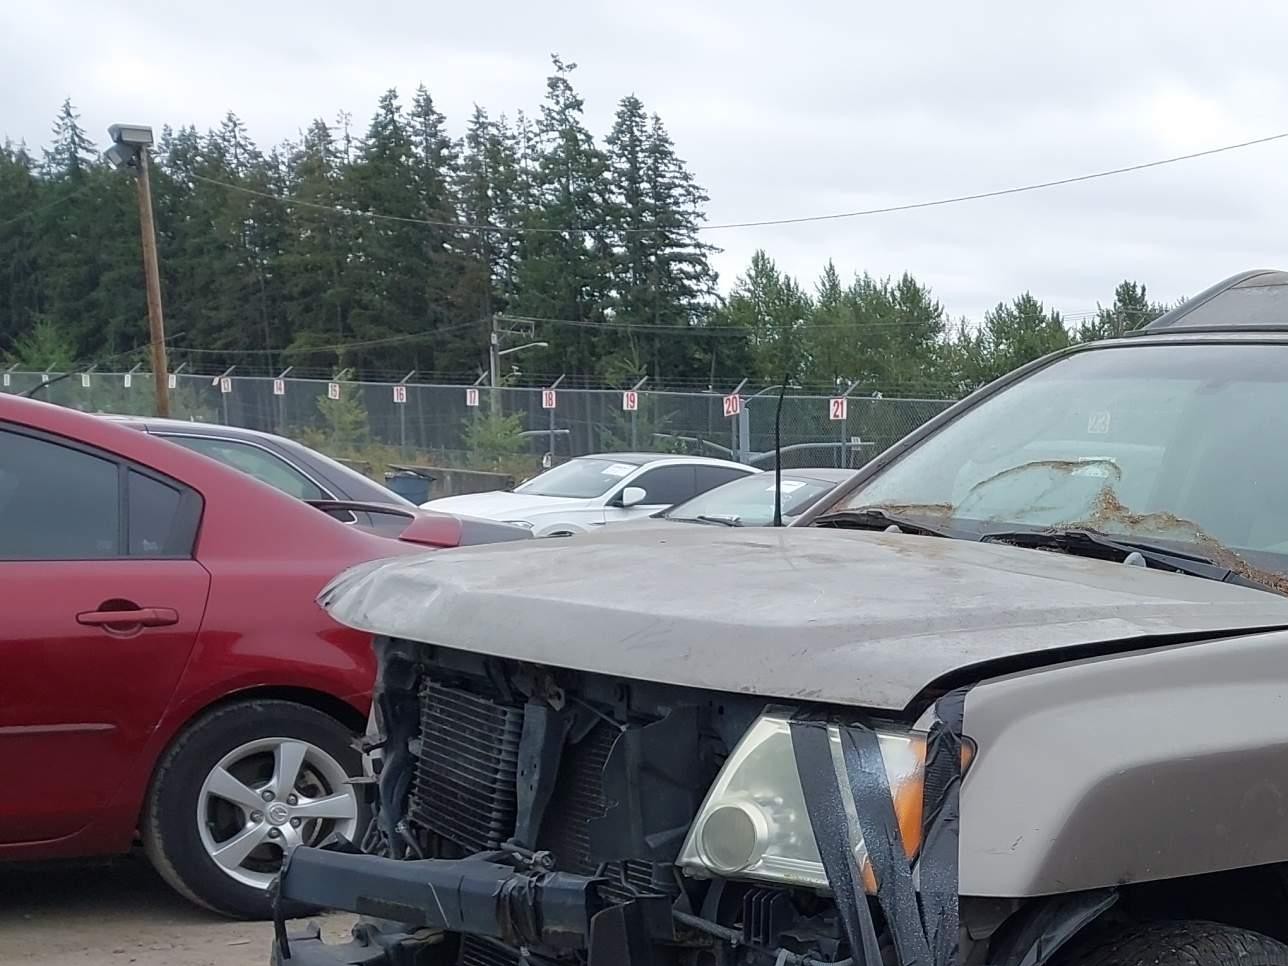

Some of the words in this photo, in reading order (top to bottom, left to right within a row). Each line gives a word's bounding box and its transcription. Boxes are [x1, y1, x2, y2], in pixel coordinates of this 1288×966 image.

[396, 387, 405, 401] 16
[469, 390, 477, 405] 17
[545, 392, 553, 407] 18
[626, 392, 636, 409] 19
[725, 397, 738, 415] 20
[833, 400, 845, 418] 21
